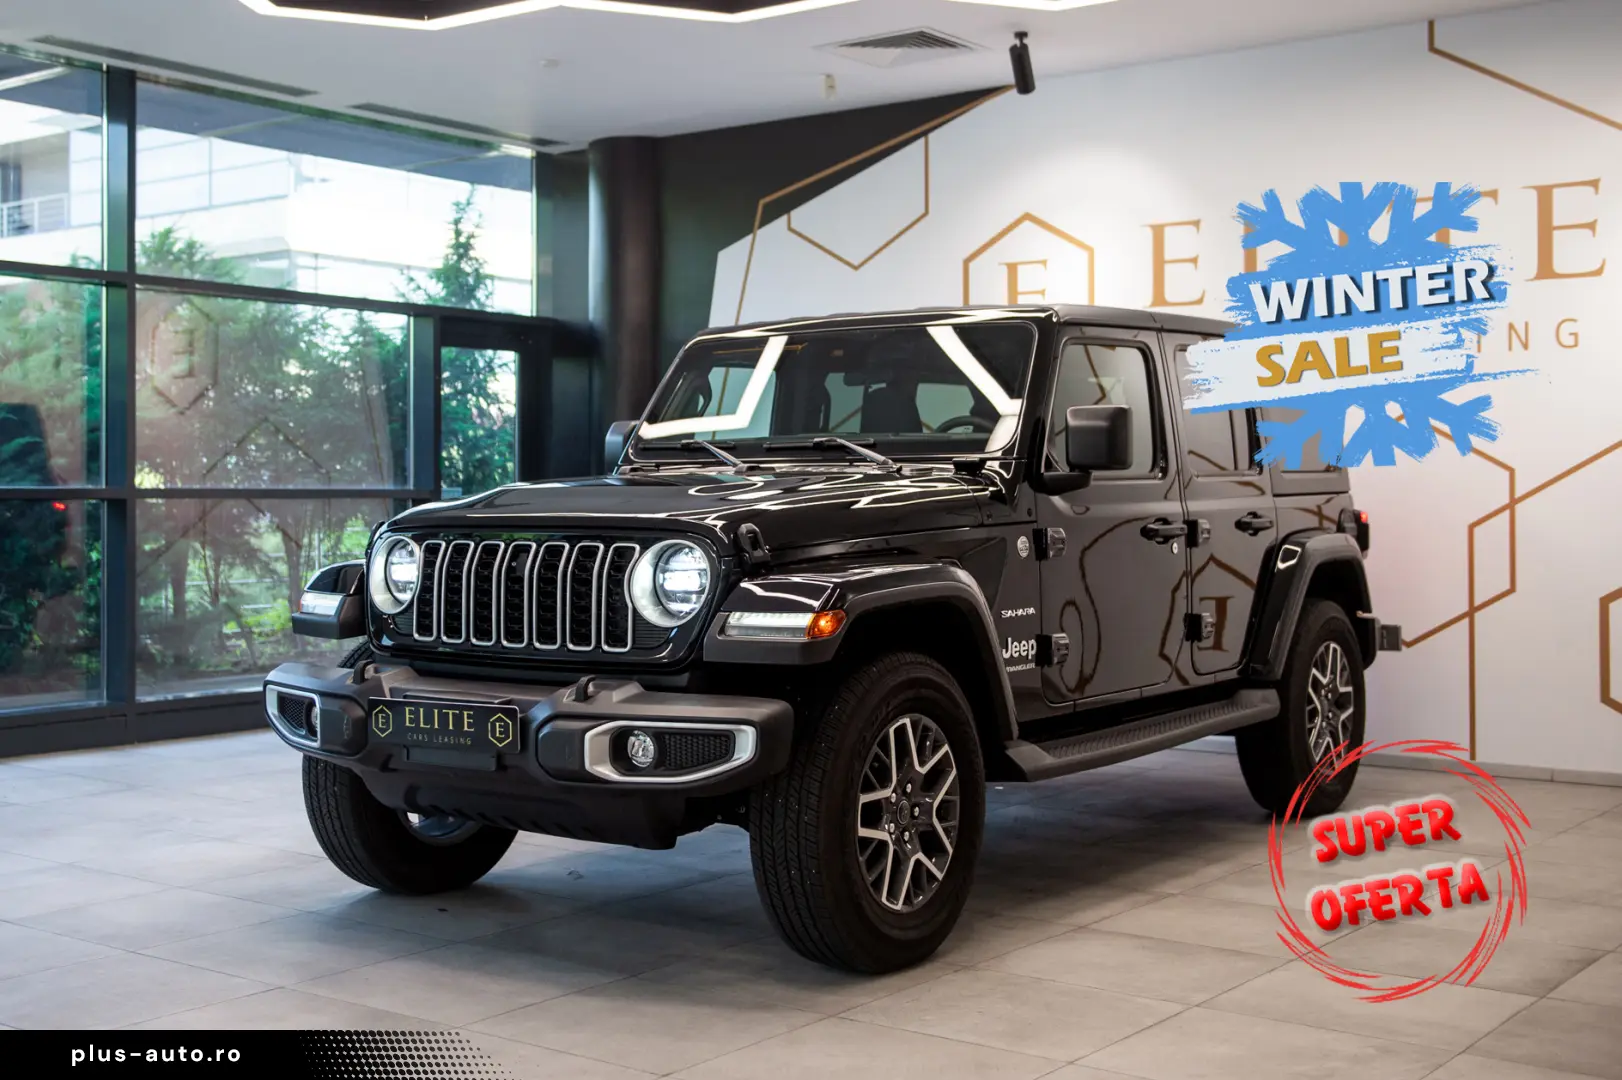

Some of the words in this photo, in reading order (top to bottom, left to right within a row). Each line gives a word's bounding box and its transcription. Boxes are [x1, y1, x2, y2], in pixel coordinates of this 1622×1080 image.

[1001, 607, 1036, 618] SAHARA
[1002, 637, 1037, 660] Jeep
[404, 706, 475, 732] ELITE
[407, 732, 428, 742] CARS
[433, 733, 472, 745] LEASING
